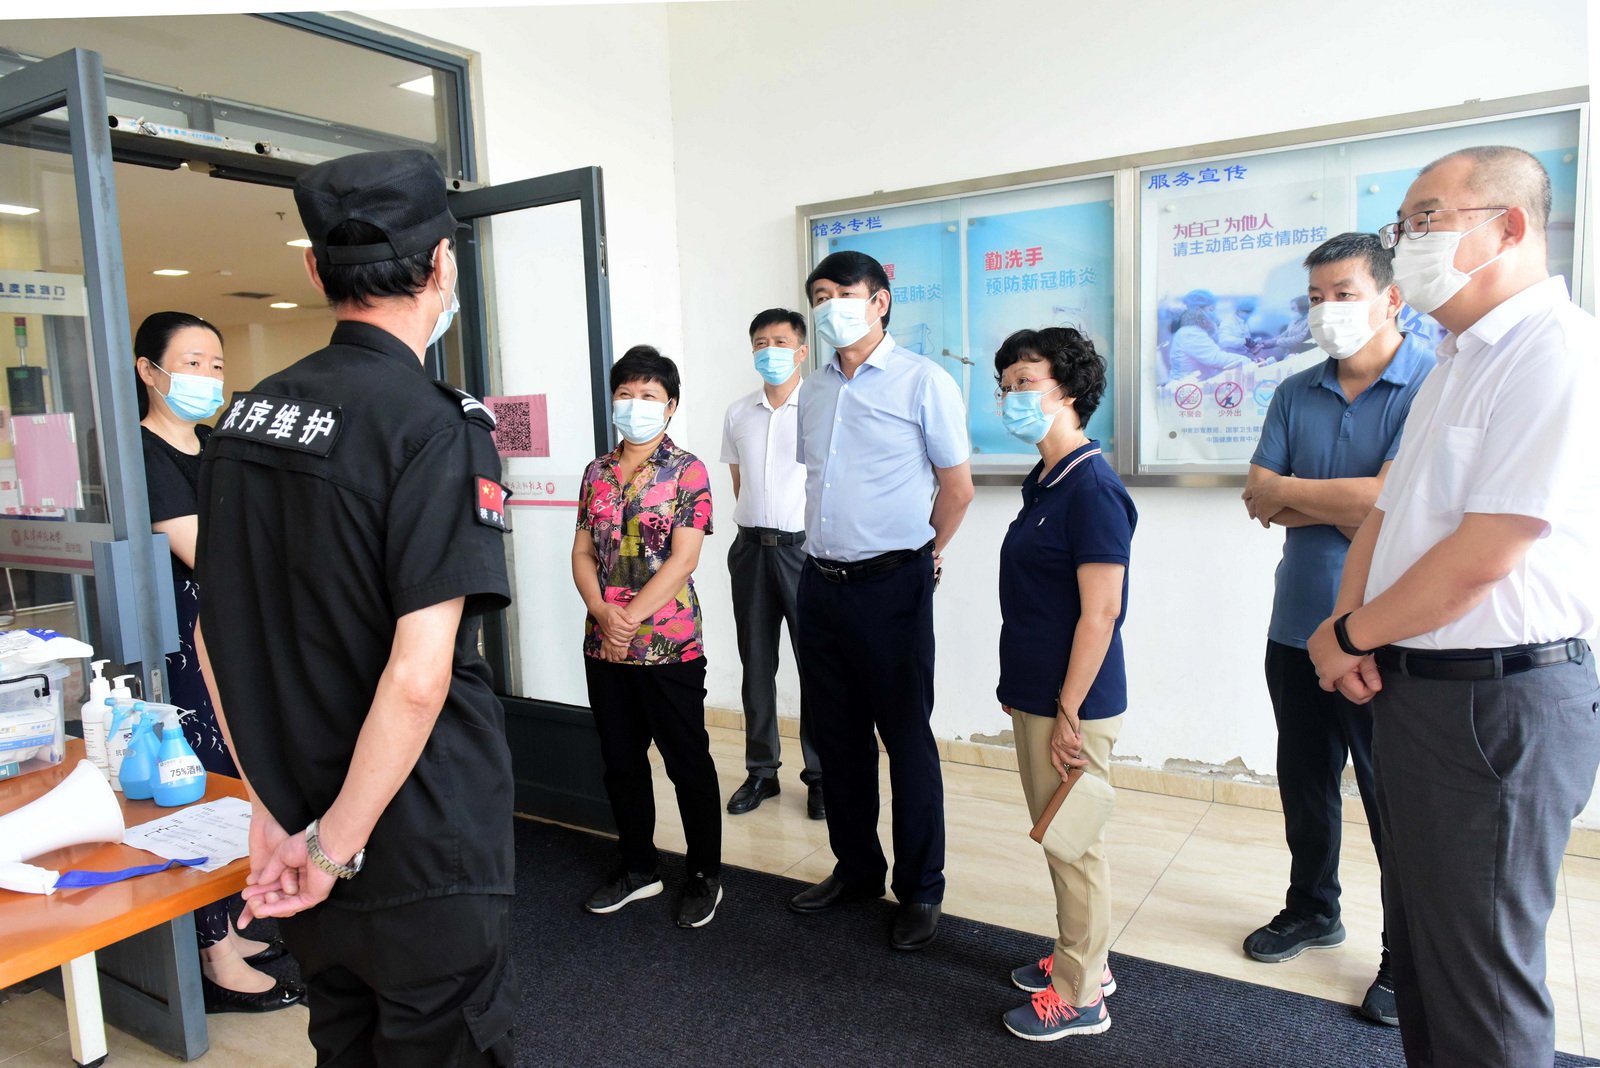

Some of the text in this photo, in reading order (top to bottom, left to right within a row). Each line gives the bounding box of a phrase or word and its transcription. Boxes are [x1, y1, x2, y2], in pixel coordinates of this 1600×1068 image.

[1148, 164, 1248, 189] 服务宣传
[812, 216, 882, 237] 馆务专栏
[1172, 213, 1274, 241] 为自己 为他人
[1173, 226, 1328, 257] 请主动配合疫情防控
[984, 246, 1044, 271] 勤洗手
[893, 283, 942, 304] 冠肺炎
[985, 267, 1097, 295] 预防新冠肺炎
[221, 397, 336, 446] 秩序维护
[1217, 409, 1242, 417] 少外出
[169, 764, 202, 778] 75%酒精
